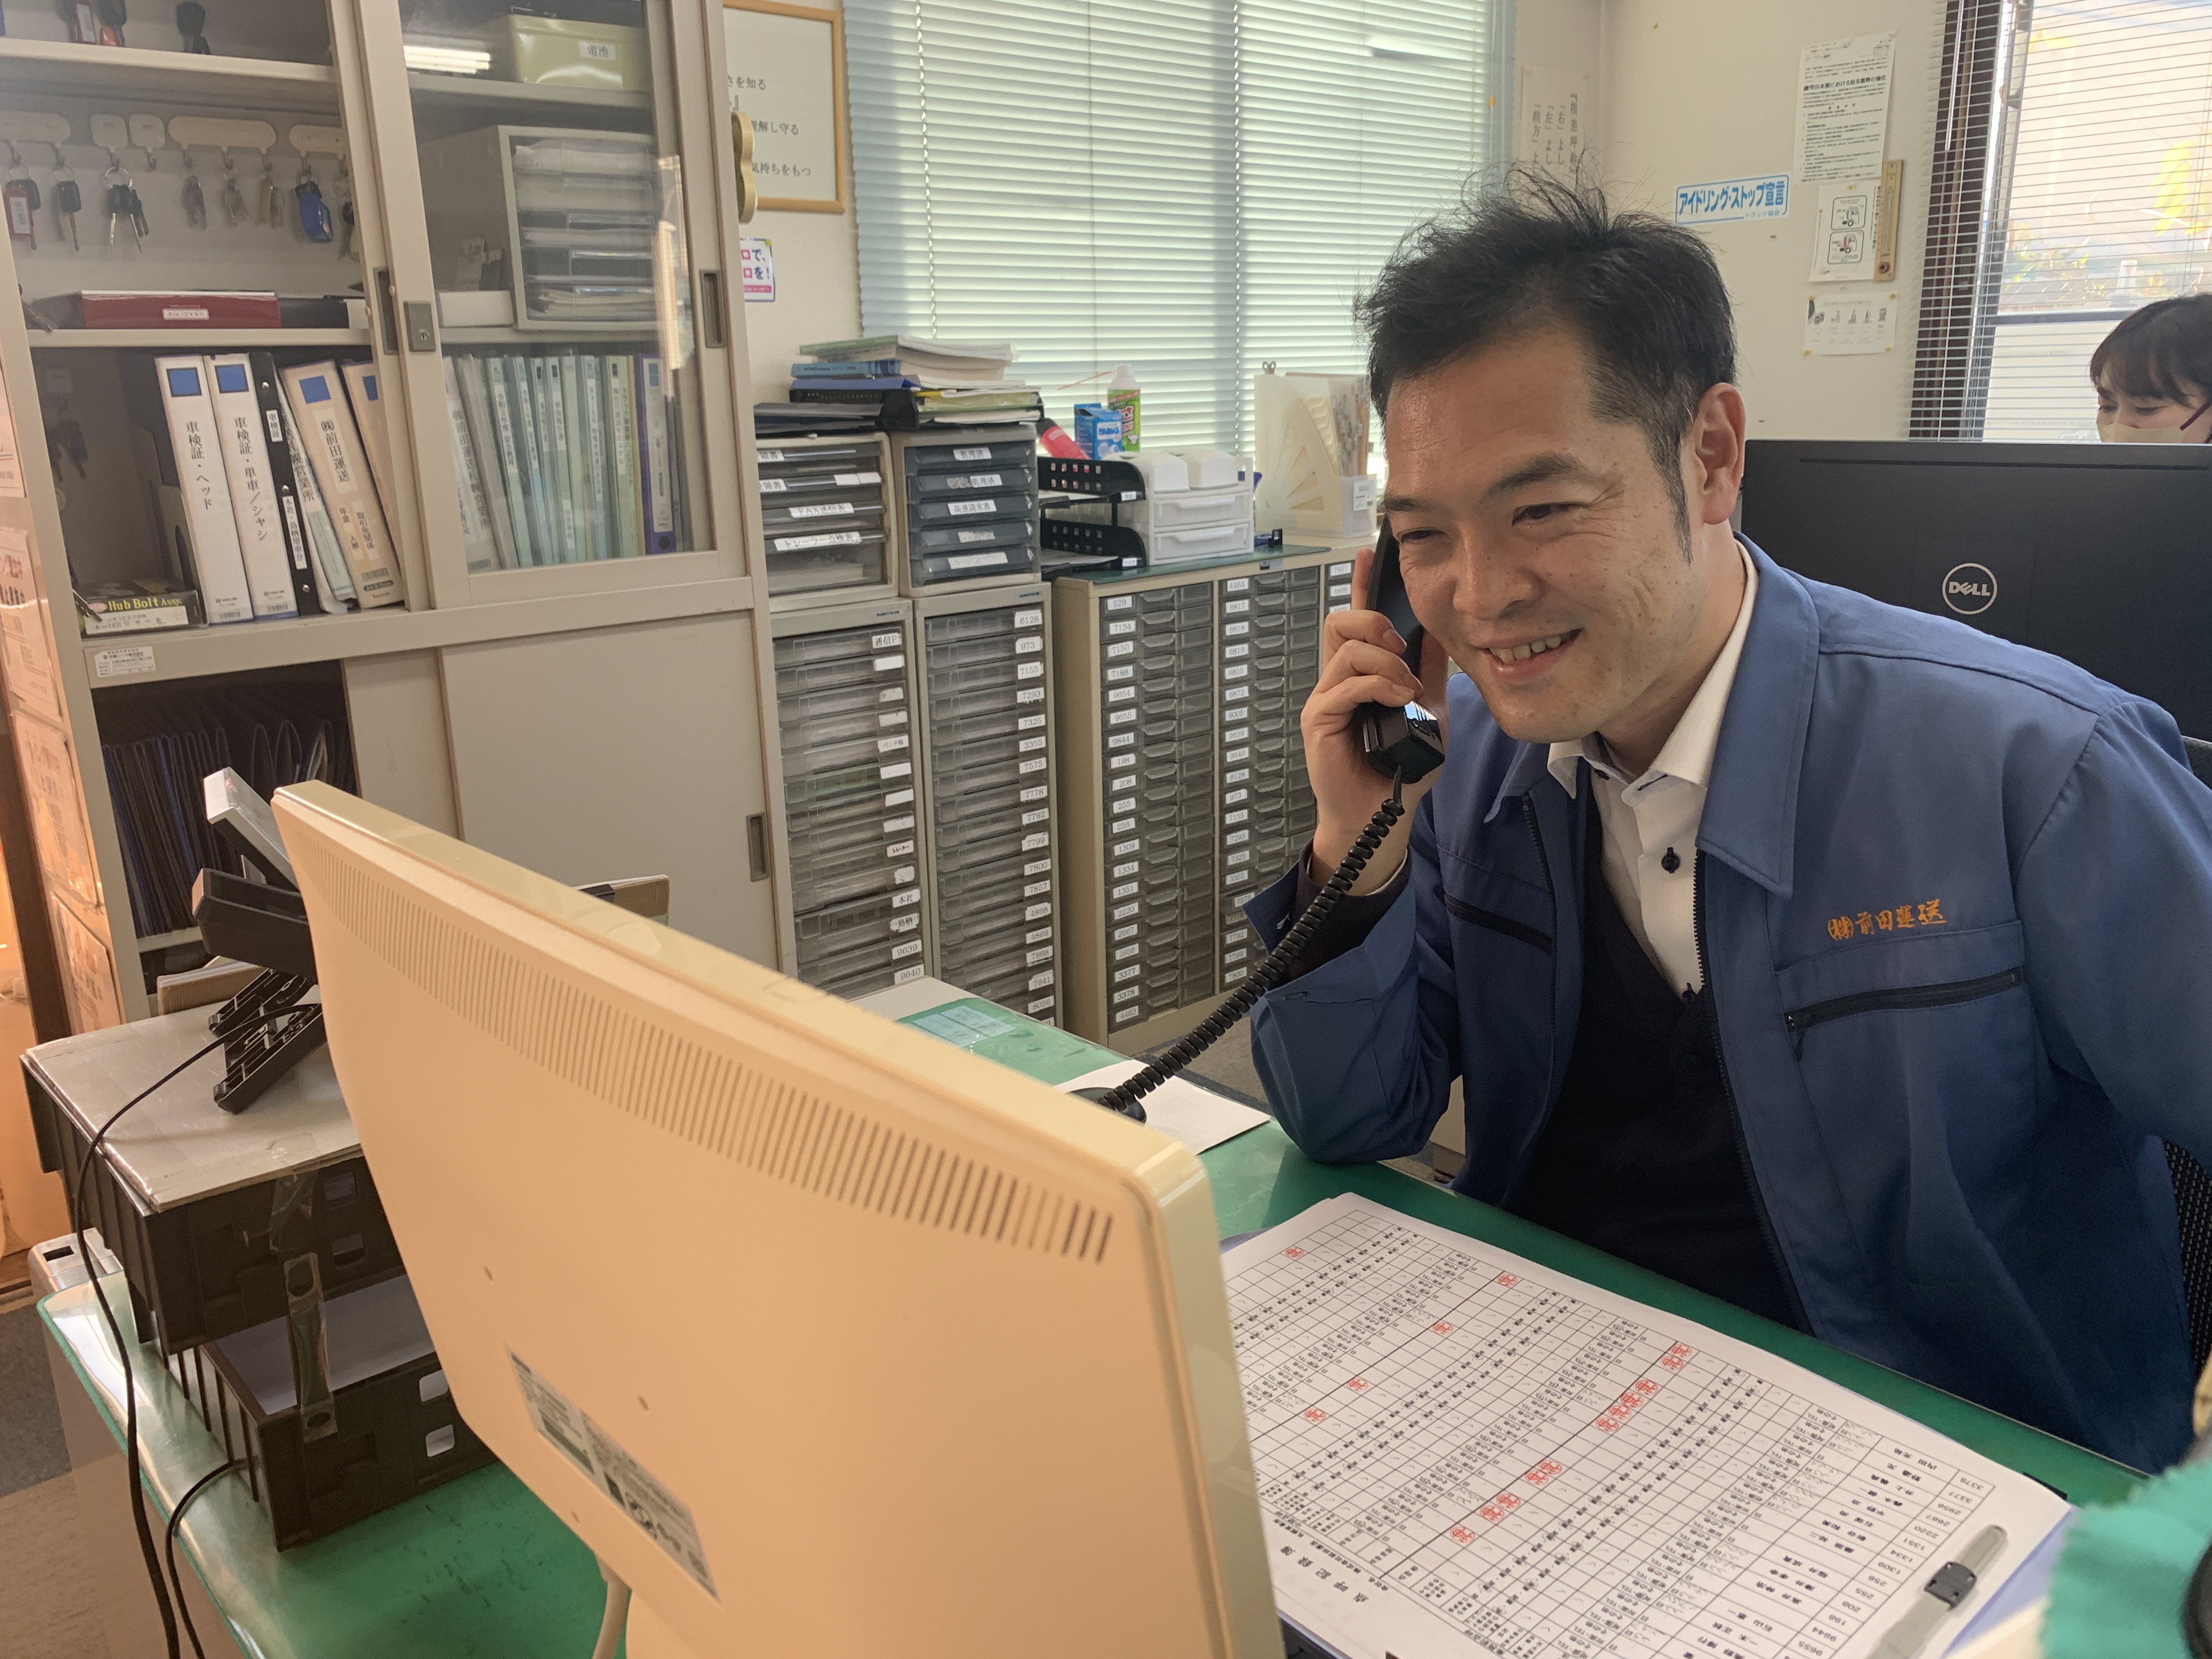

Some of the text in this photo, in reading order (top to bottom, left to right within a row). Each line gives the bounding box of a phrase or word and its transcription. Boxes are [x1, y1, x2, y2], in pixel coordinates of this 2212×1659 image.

[587, 44, 609, 58] 電池
[1545, 139, 1553, 166] よし
[1557, 139, 1565, 165] よし
[1679, 180, 1785, 216] アイドリング・ストップ宣言
[1746, 210, 1780, 219] トラック協会
[268, 413, 281, 439] 車検証
[320, 419, 351, 483] ㈱前田運送
[757, 451, 778, 461] 領書
[960, 449, 984, 459] 処理済
[185, 420, 214, 511] 車検証・ヘッド
[972, 476, 995, 486] 処理済
[953, 502, 991, 514] 高速請求書
[1229, 580, 1245, 590] 4464
[1949, 582, 1990, 596] DELL
[108, 597, 183, 611] Hub Bolt Assy.
[1113, 599, 1127, 608] 529
[1019, 615, 1040, 625] 6128
[1114, 623, 1132, 632] 7134
[874, 635, 898, 647] 通信P
[1020, 641, 1035, 651] 973
[1111, 643, 1130, 654] 7150
[1019, 665, 1039, 676] 7155
[1111, 668, 1129, 678] 7188
[1022, 690, 1041, 700] 7293
[1113, 689, 1131, 699] 9654
[1023, 716, 1042, 727] 7325
[1114, 711, 1132, 722] 9655
[1112, 735, 1130, 746] 9844
[1228, 730, 1245, 740] 9639
[1024, 738, 1043, 749] 3355
[1118, 756, 1130, 765] 198
[1229, 749, 1246, 760] 9640
[1024, 760, 1043, 771] 7575
[1229, 771, 1246, 781] 6128
[1119, 777, 1132, 788] 208
[1025, 788, 1044, 799] 7778
[1229, 791, 1242, 802] 973
[1118, 800, 1131, 810] 255
[1026, 810, 1046, 822] 7792
[1228, 811, 1244, 822] 7155
[1116, 820, 1130, 831] 256
[1026, 836, 1045, 848] 7799
[1230, 831, 1245, 843] 7293
[1119, 842, 1136, 853] 1309
[1231, 852, 1246, 863] 7325
[1029, 861, 1048, 872] 7800
[1118, 864, 1135, 875] 1334
[1229, 872, 1245, 883] 3355
[1029, 882, 1047, 894] 7857
[1118, 885, 1134, 896] 1351
[899, 893, 913, 905] 本社
[1236, 894, 1251, 905] 7575
[1030, 906, 1048, 917] 4868
[1118, 905, 1135, 917] 2220
[898, 916, 913, 928] 鳥栖
[1030, 929, 1049, 941] 4869
[1228, 931, 1244, 941] 7792
[896, 943, 918, 956] 9639
[1031, 949, 1049, 960] 7868
[1227, 950, 1244, 961] 7799
[900, 967, 921, 980] 9640
[1118, 967, 1136, 979] 3377
[1228, 969, 1244, 980] 7800
[1033, 976, 1051, 988] 7941
[1117, 988, 1136, 1001] 3378
[1032, 998, 1051, 1011] 8056
[1887, 1462, 1897, 1471] 光
[1917, 1458, 1938, 1470] 内田
[1959, 1477, 1984, 1491] 3378
[1896, 1485, 1915, 1496] 井上
[1948, 1491, 1973, 1504] 3377
[1866, 1505, 1884, 1516] 平野
[1937, 1503, 1962, 1516] 2956
[1821, 1519, 1841, 1531] 和美
[1925, 1514, 1951, 1527] 2667
[1914, 1525, 1939, 1539] 2220
[1903, 1537, 1925, 1551] 1351
[1890, 1549, 1914, 1563] 1334
[1280, 1545, 1369, 1603] 点呼記録簿
[1808, 1567, 1829, 1579] 福井
[1877, 1561, 1901, 1575] 1309
[1368, 1576, 1389, 1592] 会社名
[1867, 1575, 1887, 1587] 256
[1855, 1588, 1875, 1600] 255
[1841, 1600, 1862, 1613] 208
[1752, 1619, 1773, 1633] 石山
[1828, 1614, 1847, 1627] 198
[1812, 1626, 1837, 1643] 9844
[1798, 1641, 1824, 1657] 9655
